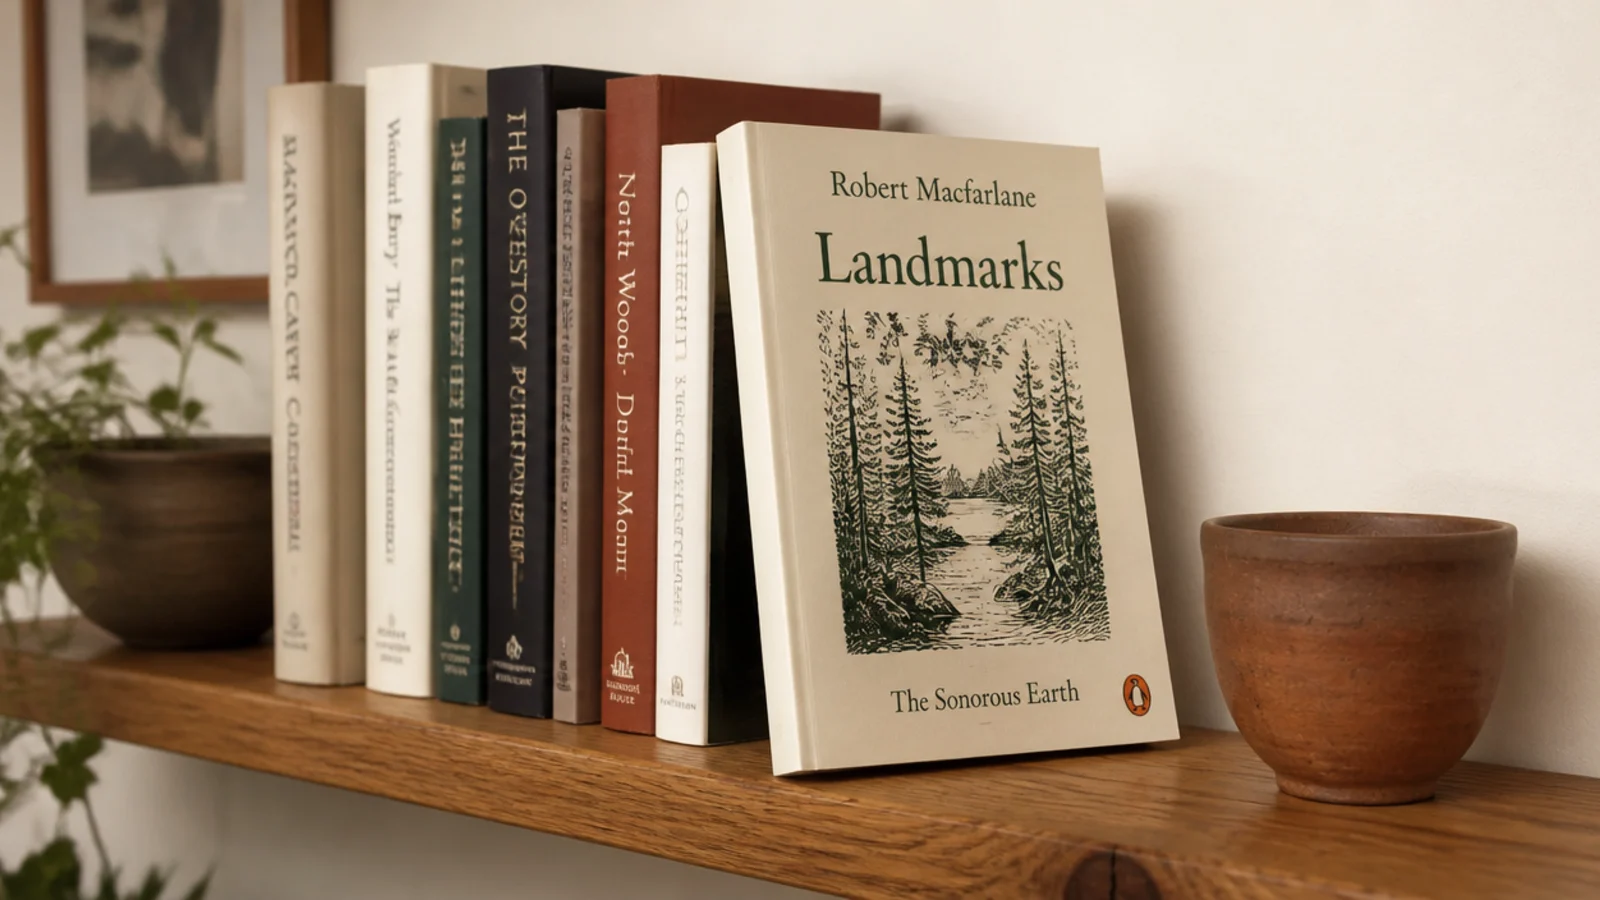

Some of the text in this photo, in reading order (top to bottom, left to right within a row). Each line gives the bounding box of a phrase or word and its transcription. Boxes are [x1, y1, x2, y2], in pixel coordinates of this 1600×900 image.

[506, 106, 528, 174] THE
[830, 170, 1037, 208] Robert Macfarlane
[814, 231, 1065, 291] Landmarks
[890, 678, 1080, 713] The Sonorous Earth
